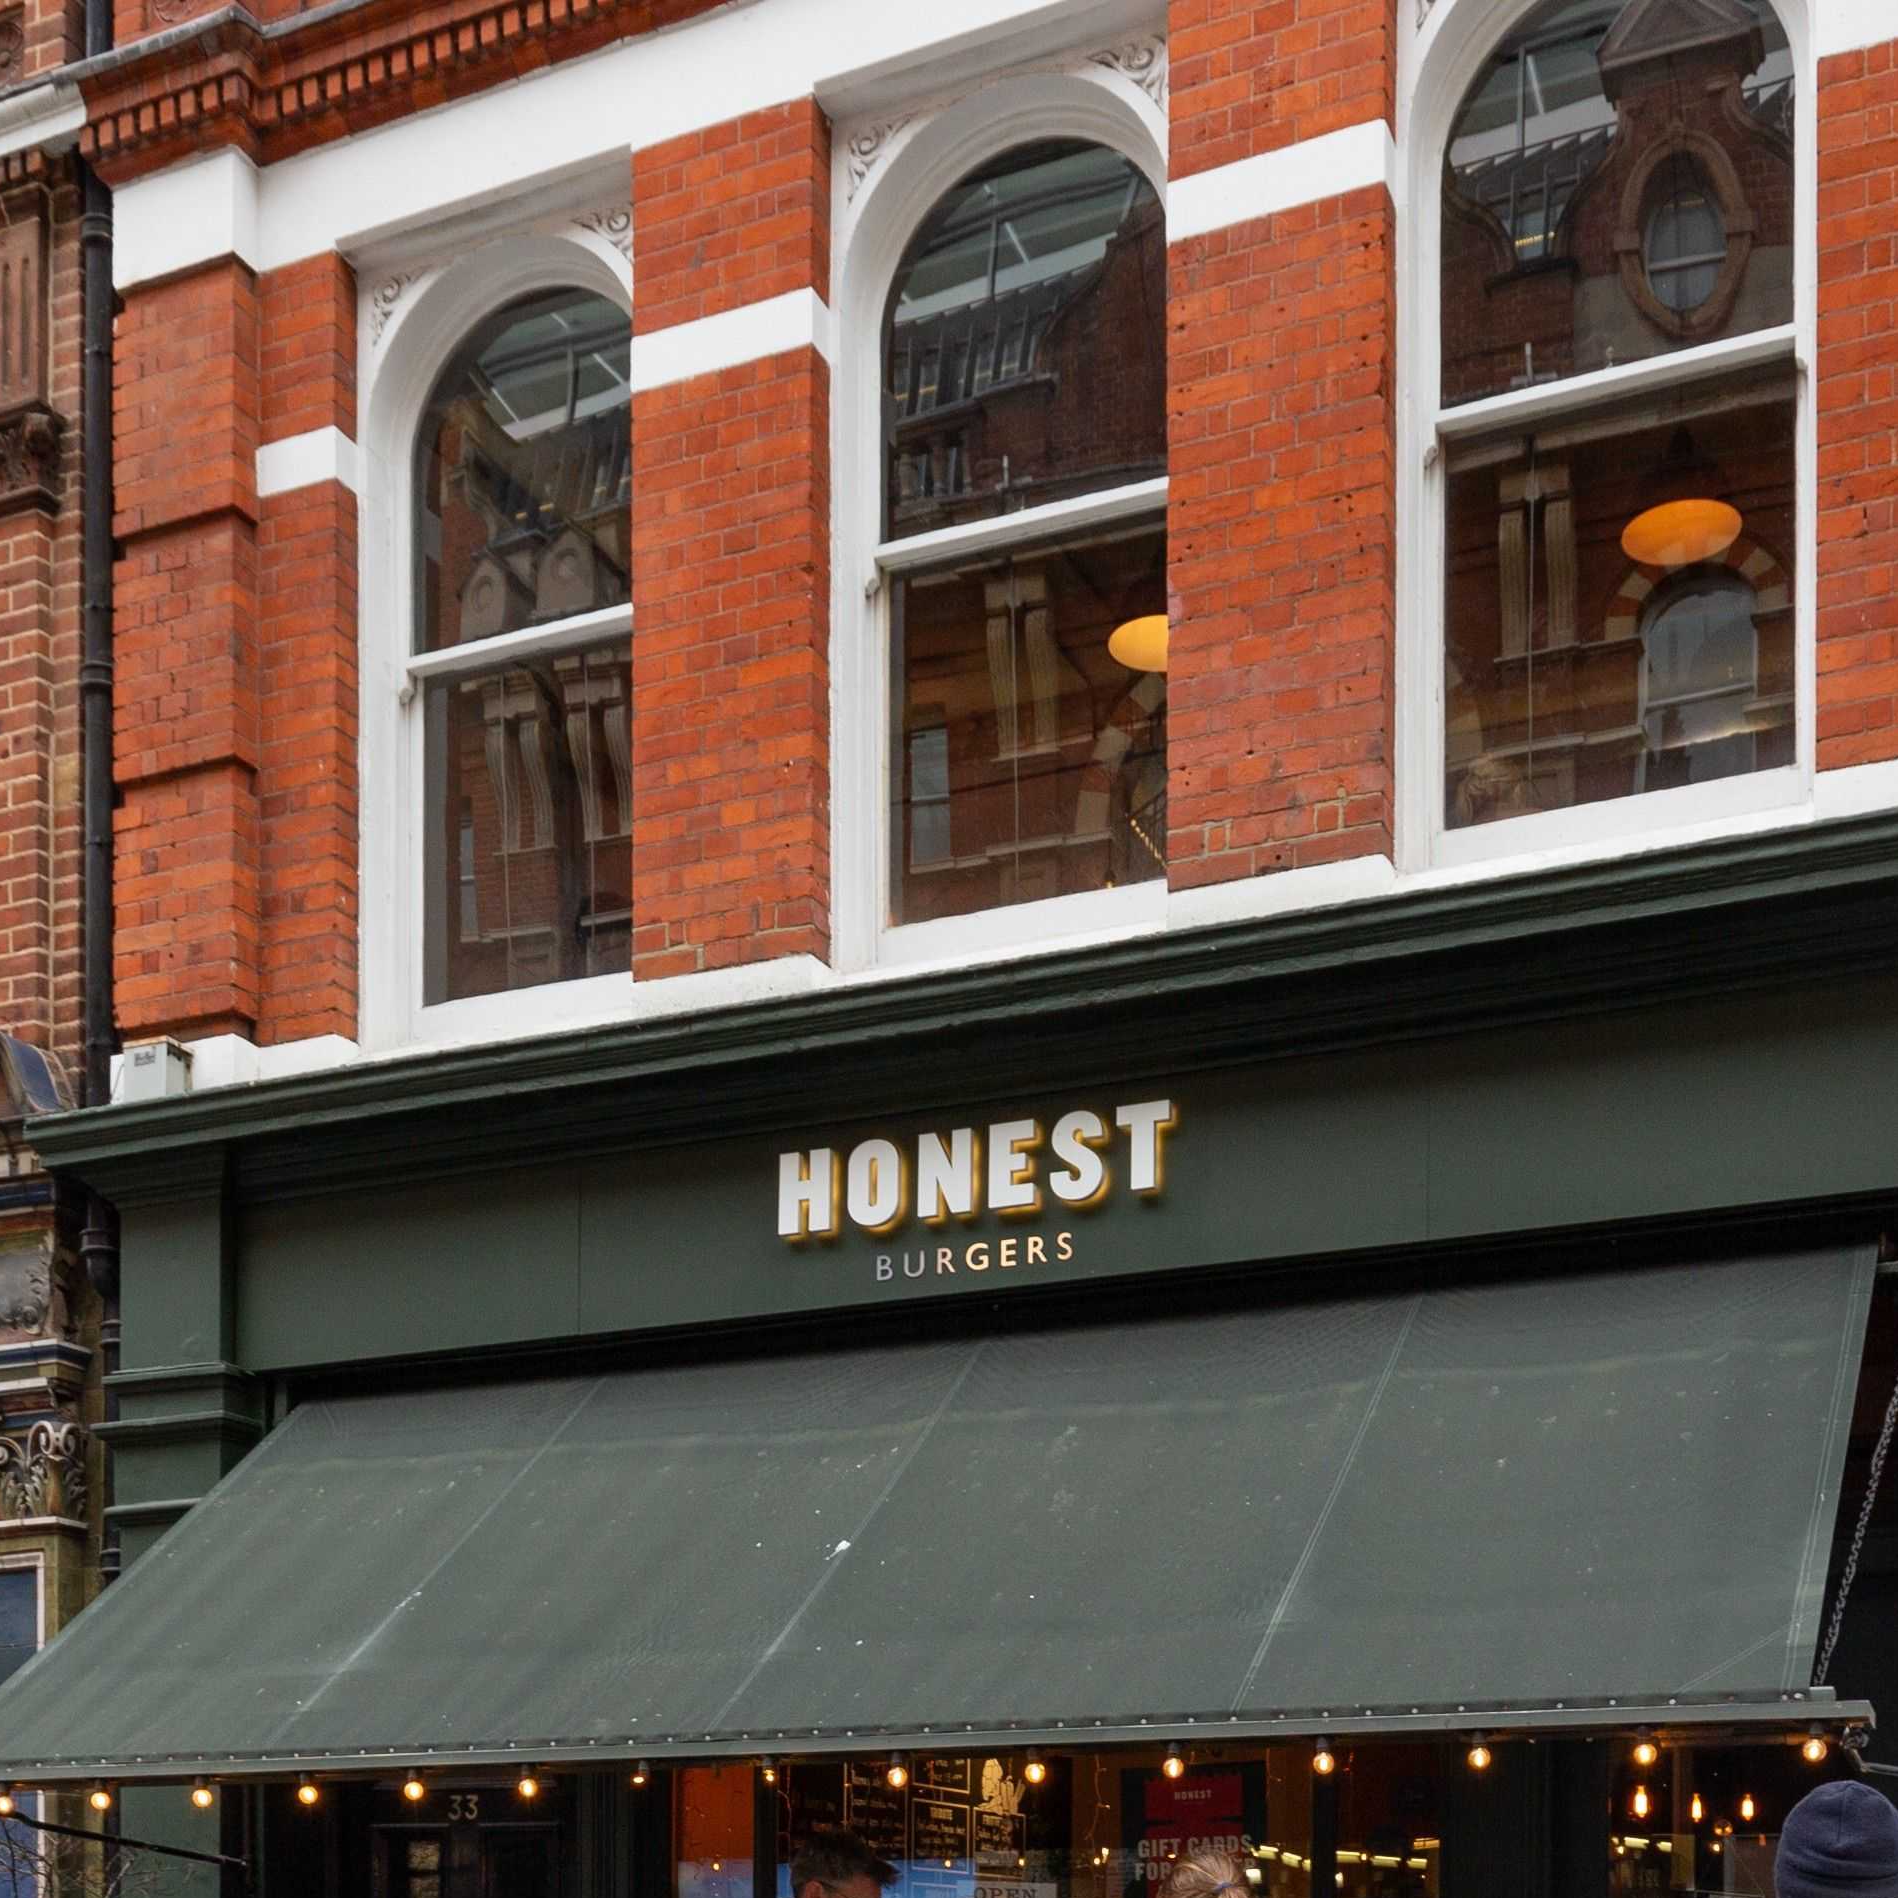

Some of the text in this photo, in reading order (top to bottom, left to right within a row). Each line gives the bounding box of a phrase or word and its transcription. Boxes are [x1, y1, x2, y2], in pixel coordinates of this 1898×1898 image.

[777, 1098, 1173, 1238] HONEST
[875, 1230, 1074, 1282] BURGERS
[447, 1793, 479, 1821] 33
[1173, 1789, 1212, 1801] HONEST
[1137, 1838, 1181, 1859] GIFT
